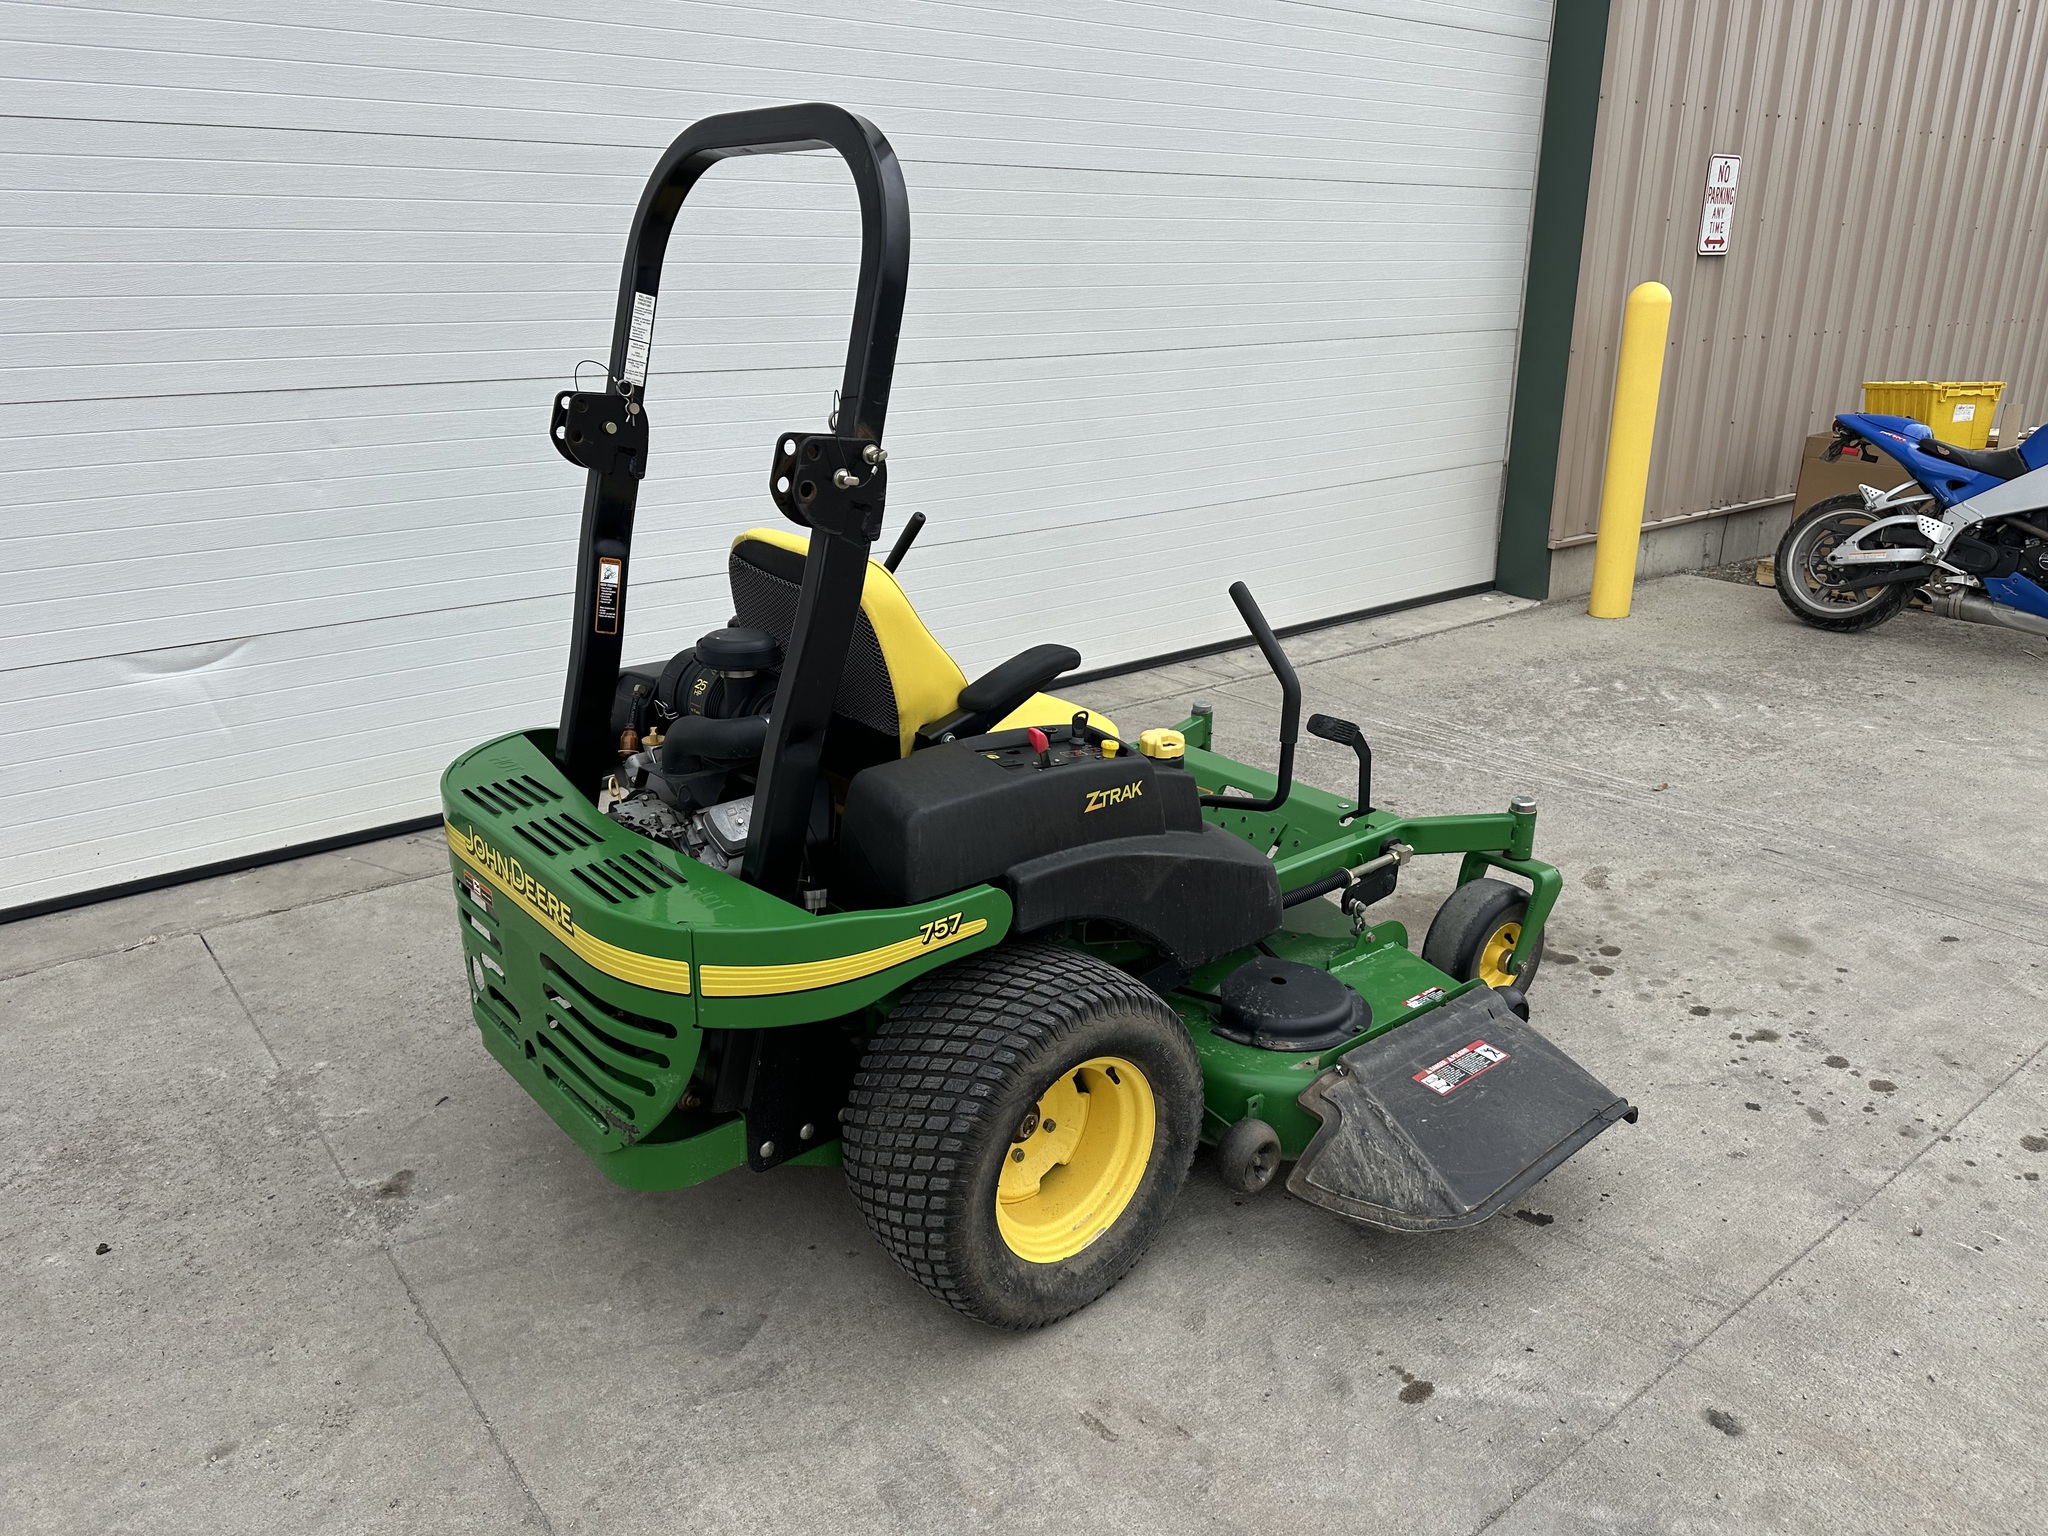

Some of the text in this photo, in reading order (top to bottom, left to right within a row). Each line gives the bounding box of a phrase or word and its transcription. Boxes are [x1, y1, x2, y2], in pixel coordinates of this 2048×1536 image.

[1718, 165, 1731, 183] NO
[1707, 187, 1734, 205] PARKING
[1712, 207, 1725, 219] ANY
[1709, 222, 1724, 234] TIME
[694, 678, 708, 691] 25
[1083, 780, 1143, 814] ZTRAK
[465, 825, 511, 885] JOHN
[509, 857, 575, 938] DEERE
[919, 911, 964, 945] 757
